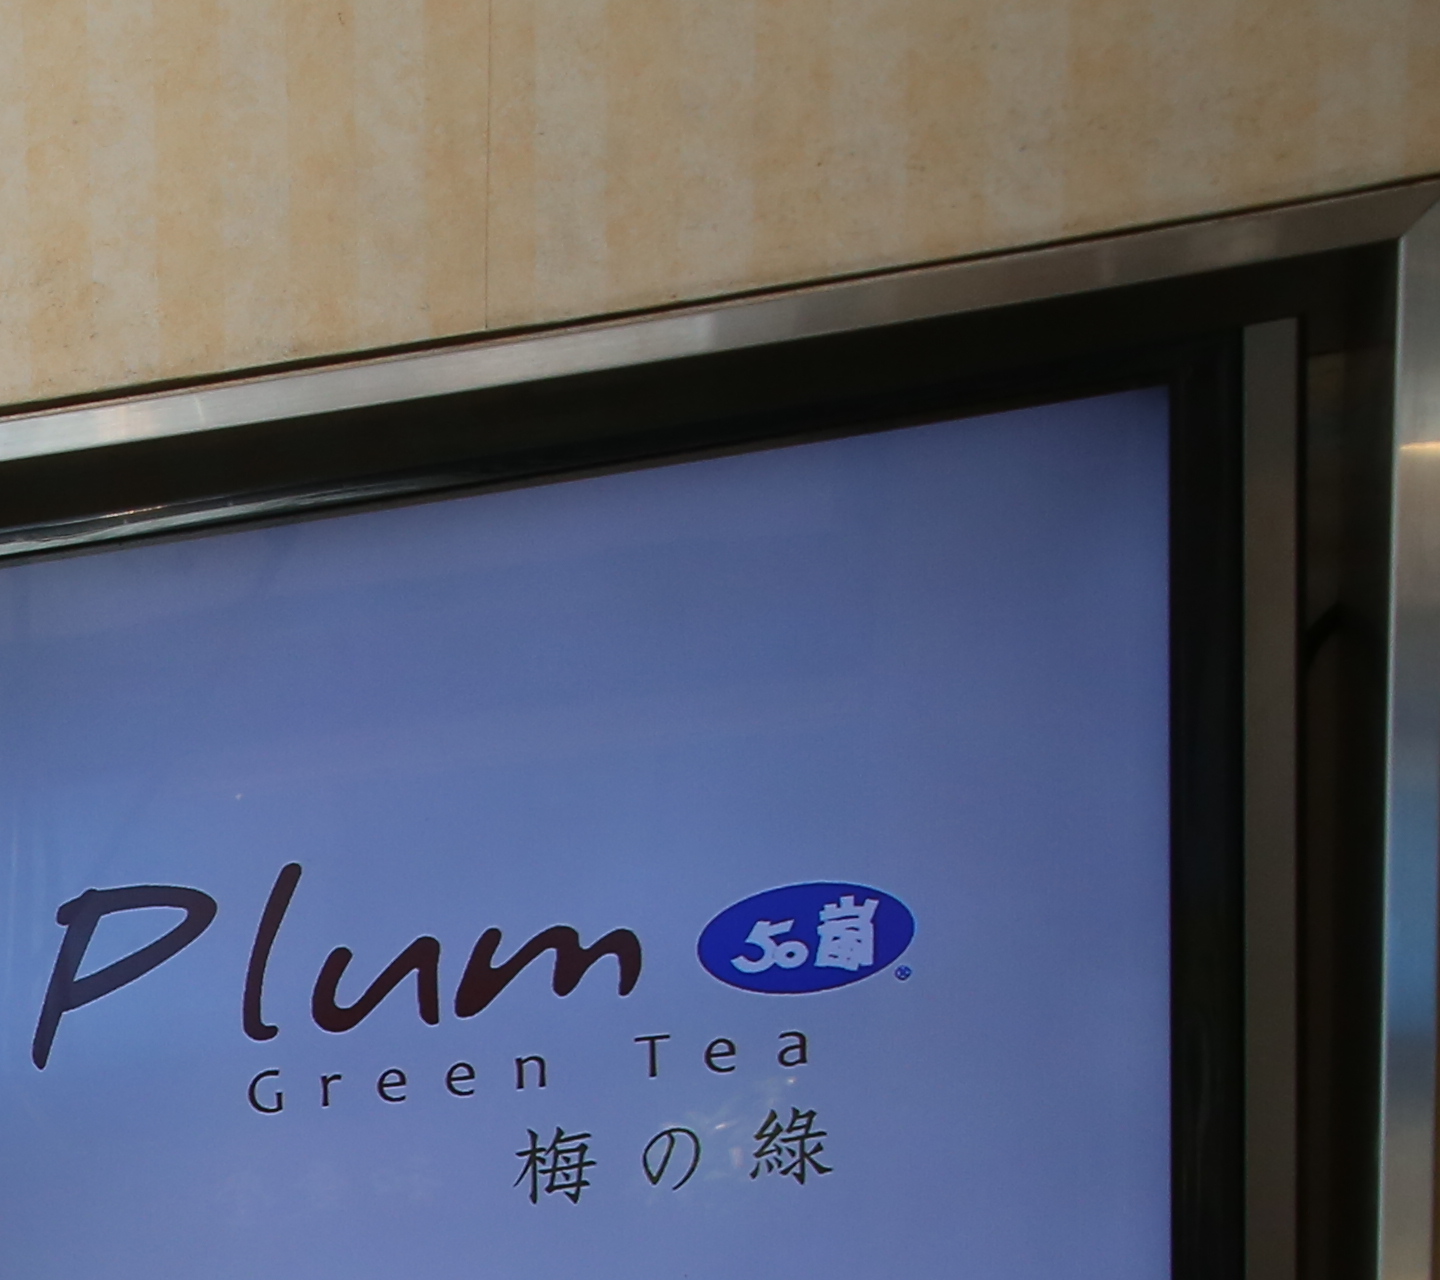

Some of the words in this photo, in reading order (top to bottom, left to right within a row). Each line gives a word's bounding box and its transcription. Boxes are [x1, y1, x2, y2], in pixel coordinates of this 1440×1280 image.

[31, 862, 642, 1069] Plum
[248, 1049, 549, 1114] Green
[634, 1028, 809, 1079] Tea
[512, 1106, 832, 1204] 梅の綠
